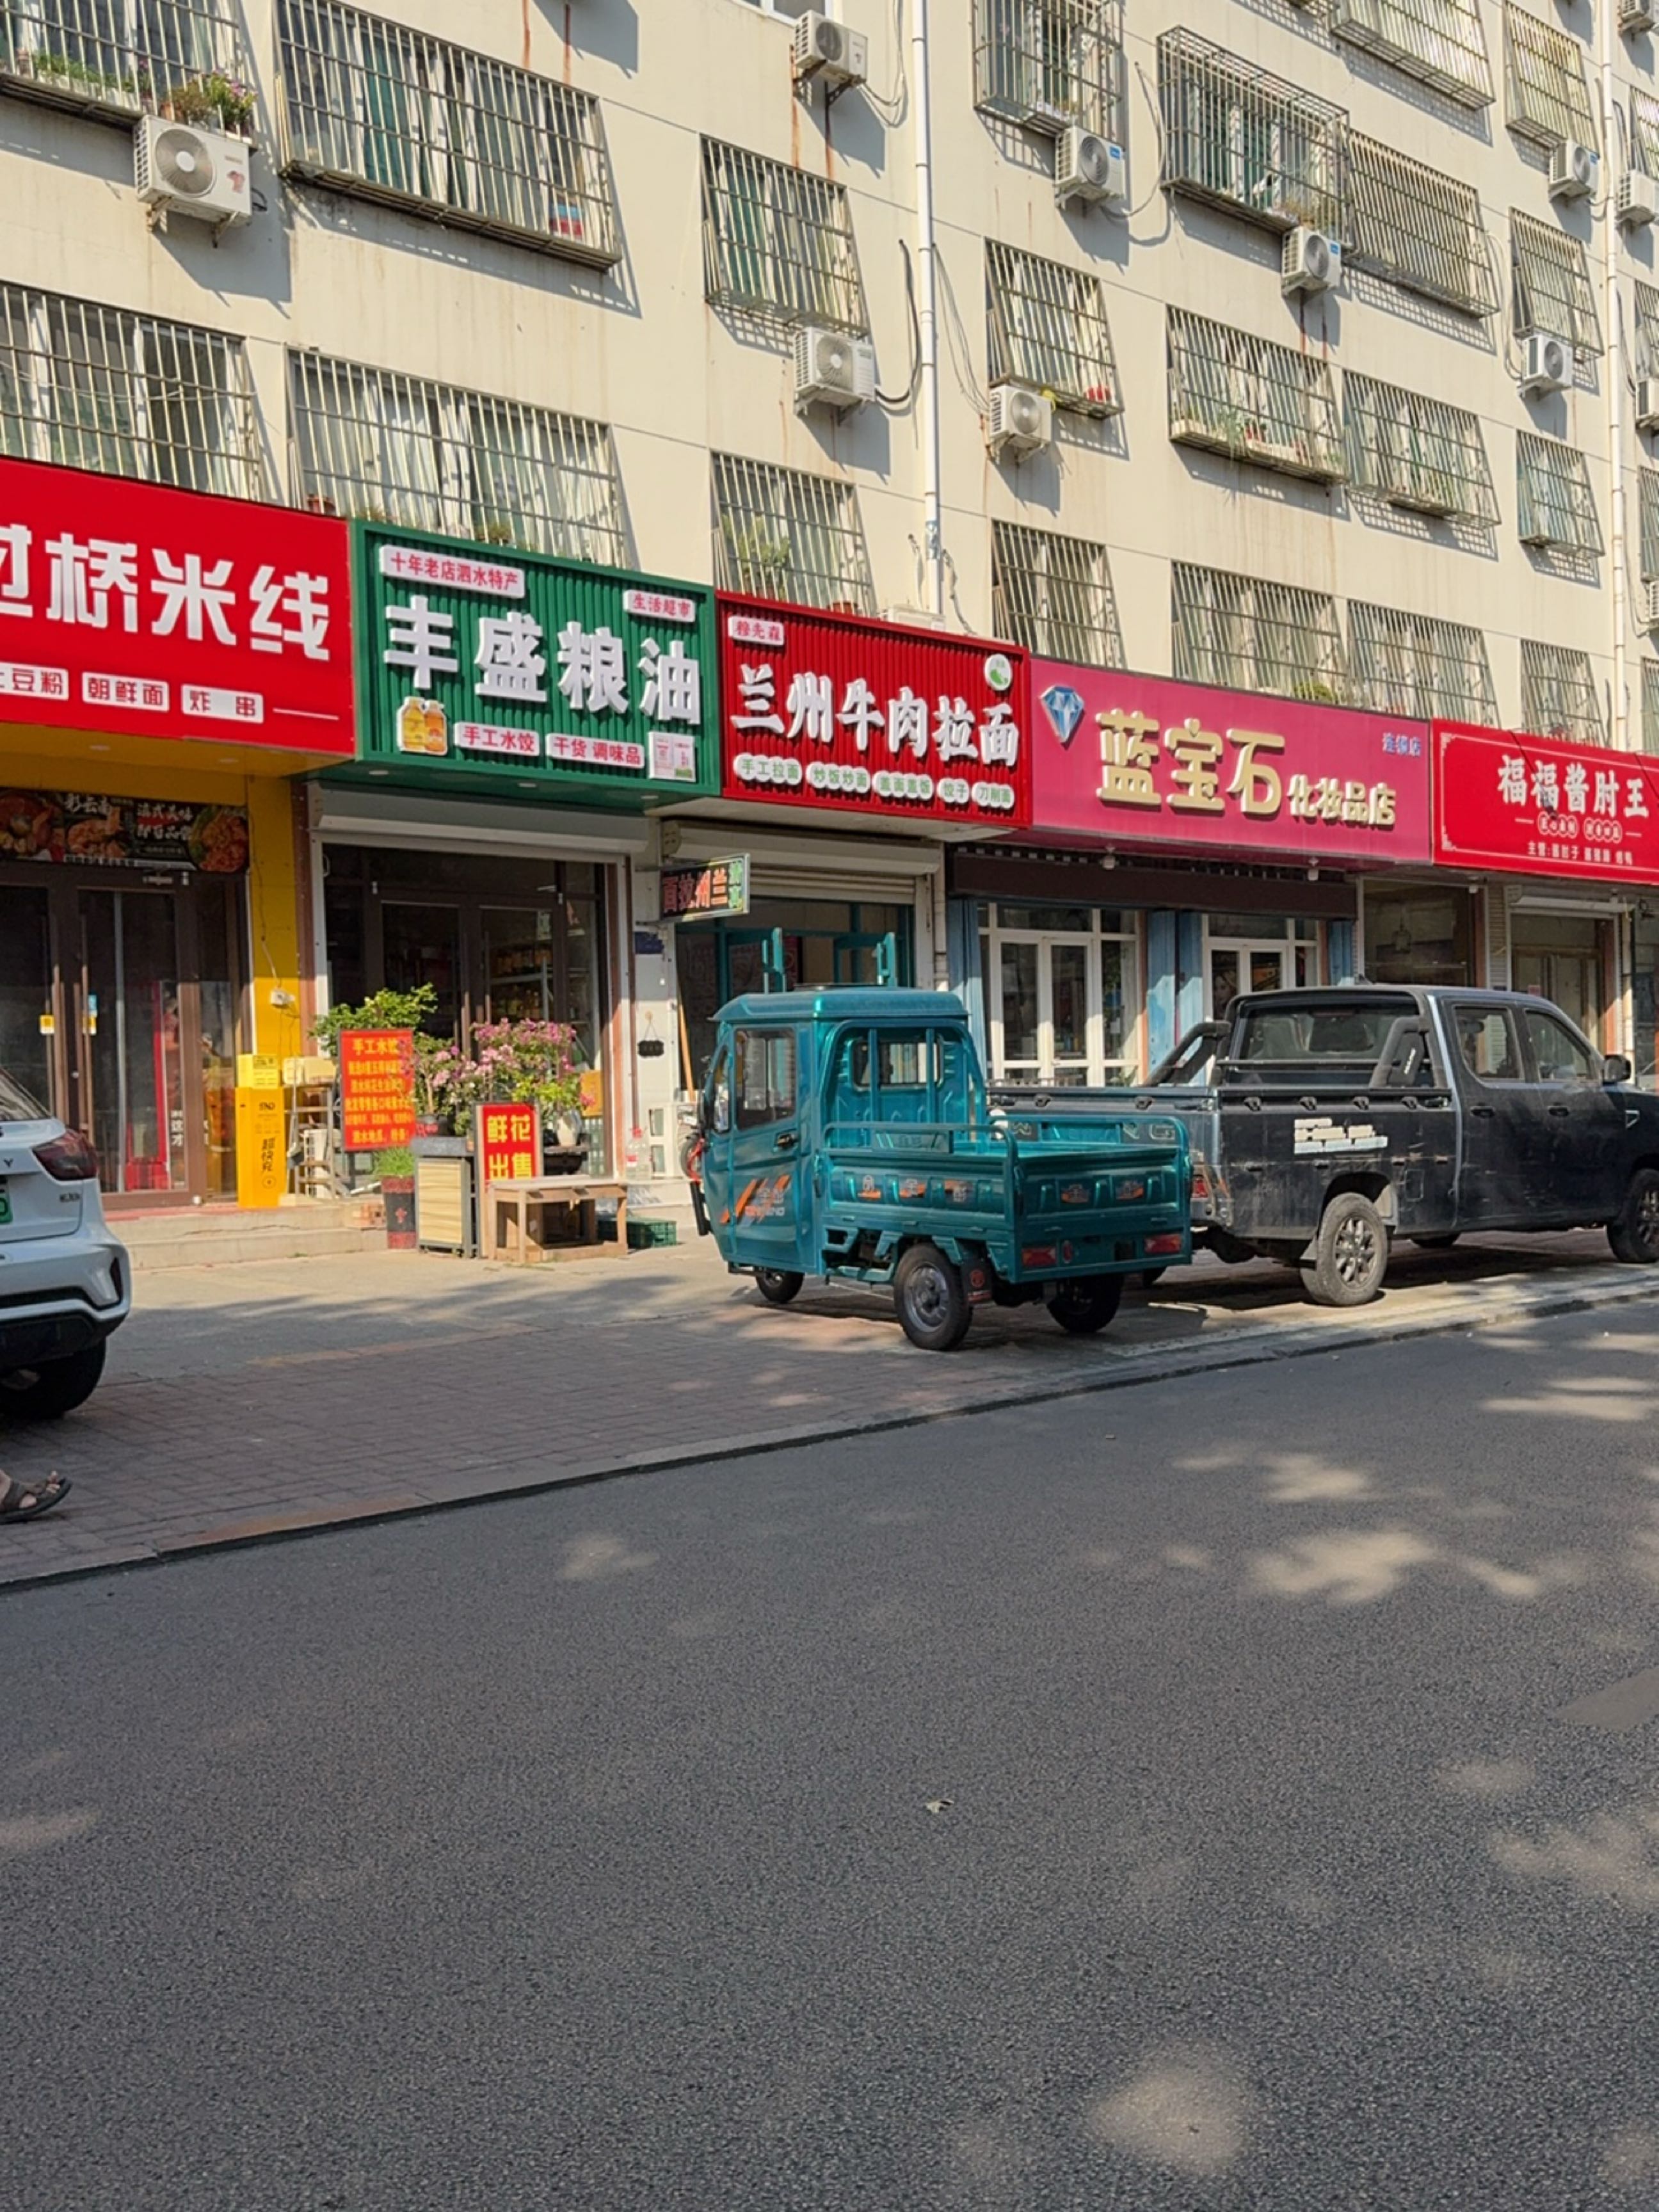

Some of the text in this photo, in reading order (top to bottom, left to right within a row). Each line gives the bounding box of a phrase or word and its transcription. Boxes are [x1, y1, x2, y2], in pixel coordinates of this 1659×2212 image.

[390, 552, 518, 589] 十年老店泗水特产
[633, 594, 691, 618] 生活超市
[385, 595, 701, 724] 丰盛粮油
[87, 677, 164, 706] 朝鲜面
[731, 663, 1019, 766] 兰州牛肉拉面
[463, 725, 535, 752] 手工水饺
[742, 758, 799, 780] 手工拉面
[1095, 708, 1396, 826] 蓝宝石 化妆品店
[1497, 754, 1649, 818] 福福酱肘王
[487, 1114, 531, 1143] 鲜花
[488, 1152, 532, 1180] 出售
